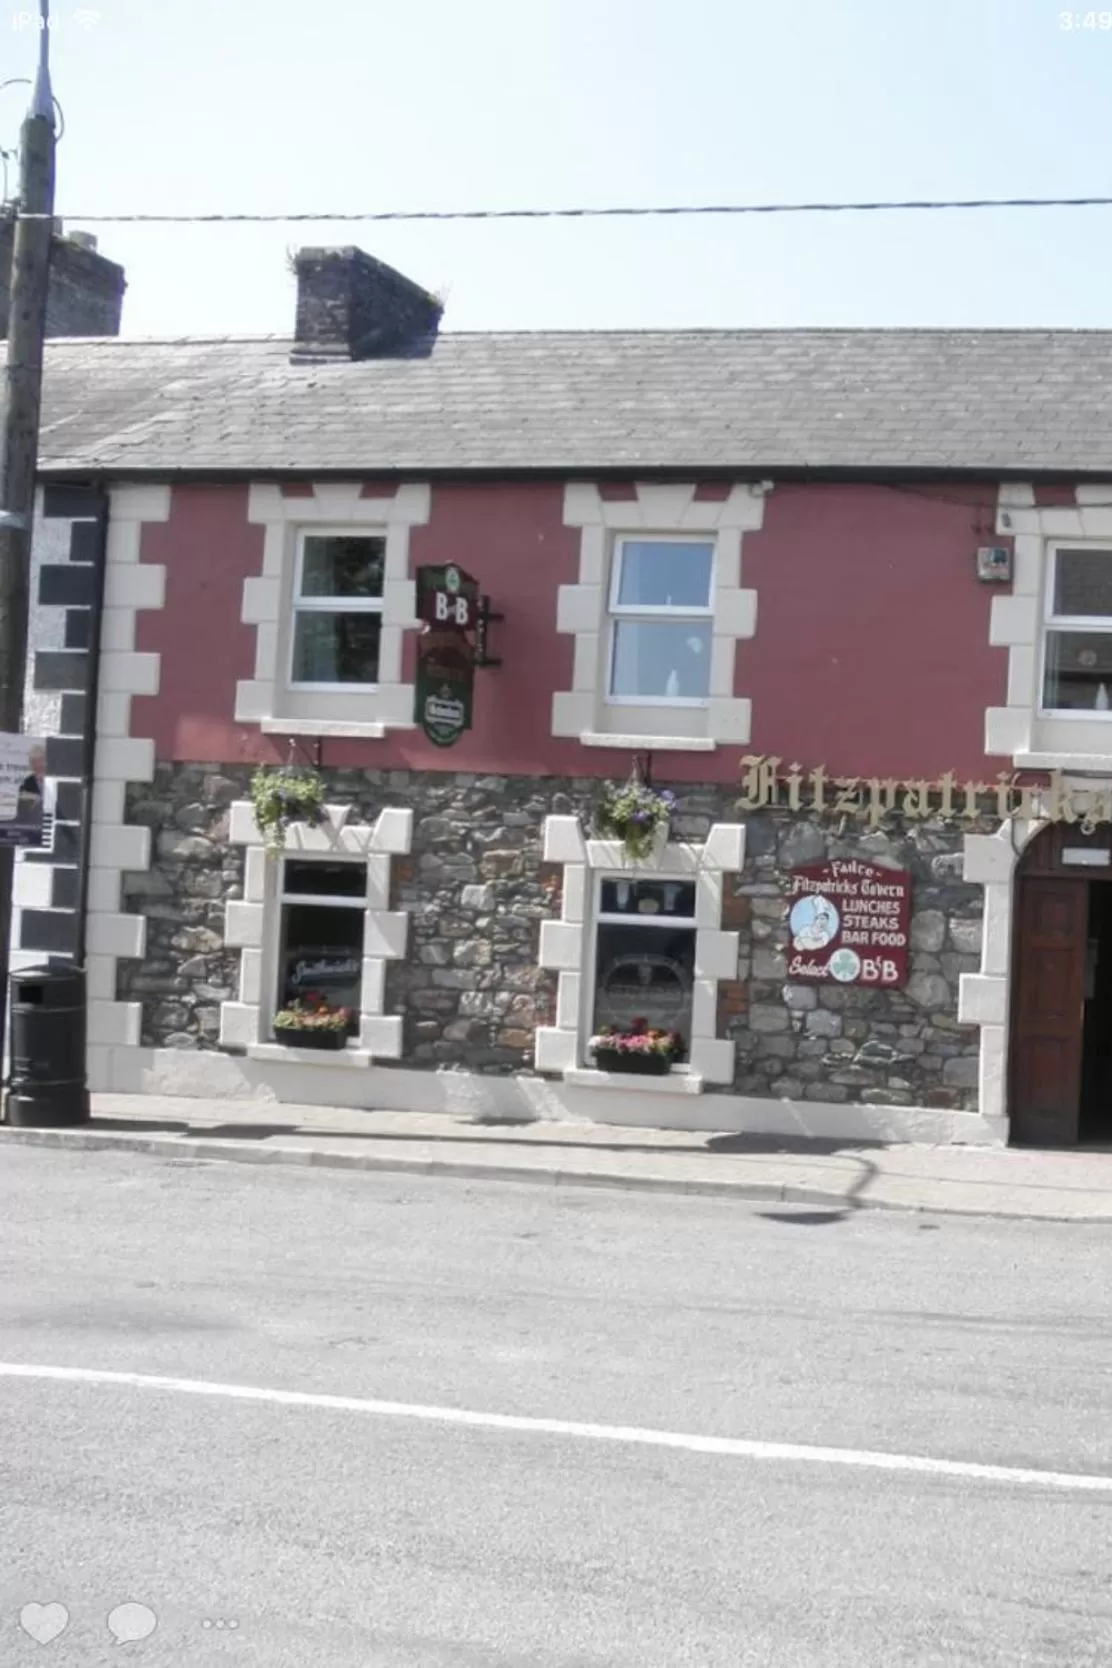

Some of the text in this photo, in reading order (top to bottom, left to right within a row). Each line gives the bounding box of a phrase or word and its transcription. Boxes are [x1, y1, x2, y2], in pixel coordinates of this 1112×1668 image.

[842, 899, 901, 915] LUNCHES
[842, 914, 900, 930] STEAKS
[842, 930, 907, 947] BAR FOOD
